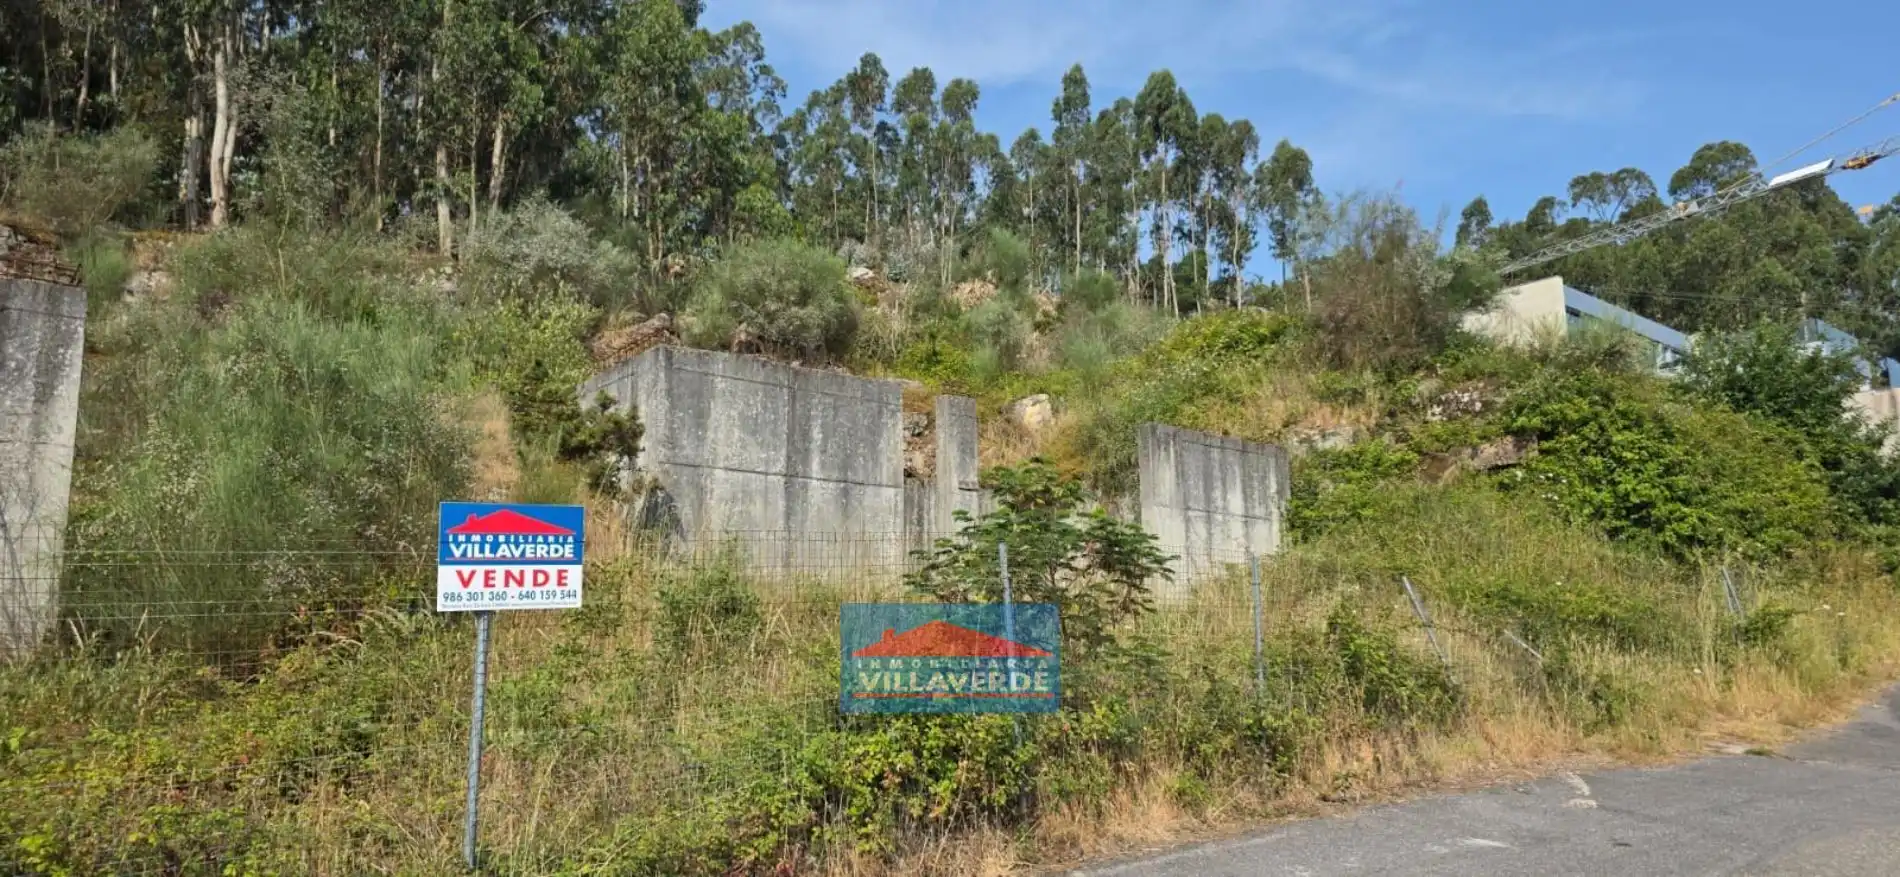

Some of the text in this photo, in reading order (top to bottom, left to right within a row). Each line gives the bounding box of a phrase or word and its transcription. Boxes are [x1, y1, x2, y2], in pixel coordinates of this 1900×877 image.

[448, 534, 574, 543] INMOBILIARIA
[449, 543, 574, 558] VILLAVERDE
[456, 569, 569, 589] VENDE
[443, 591, 462, 602] 986
[466, 591, 484, 602] 301
[488, 591, 508, 601] 360
[518, 590, 536, 600] 640
[540, 590, 557, 600] 159
[560, 589, 577, 599] 544
